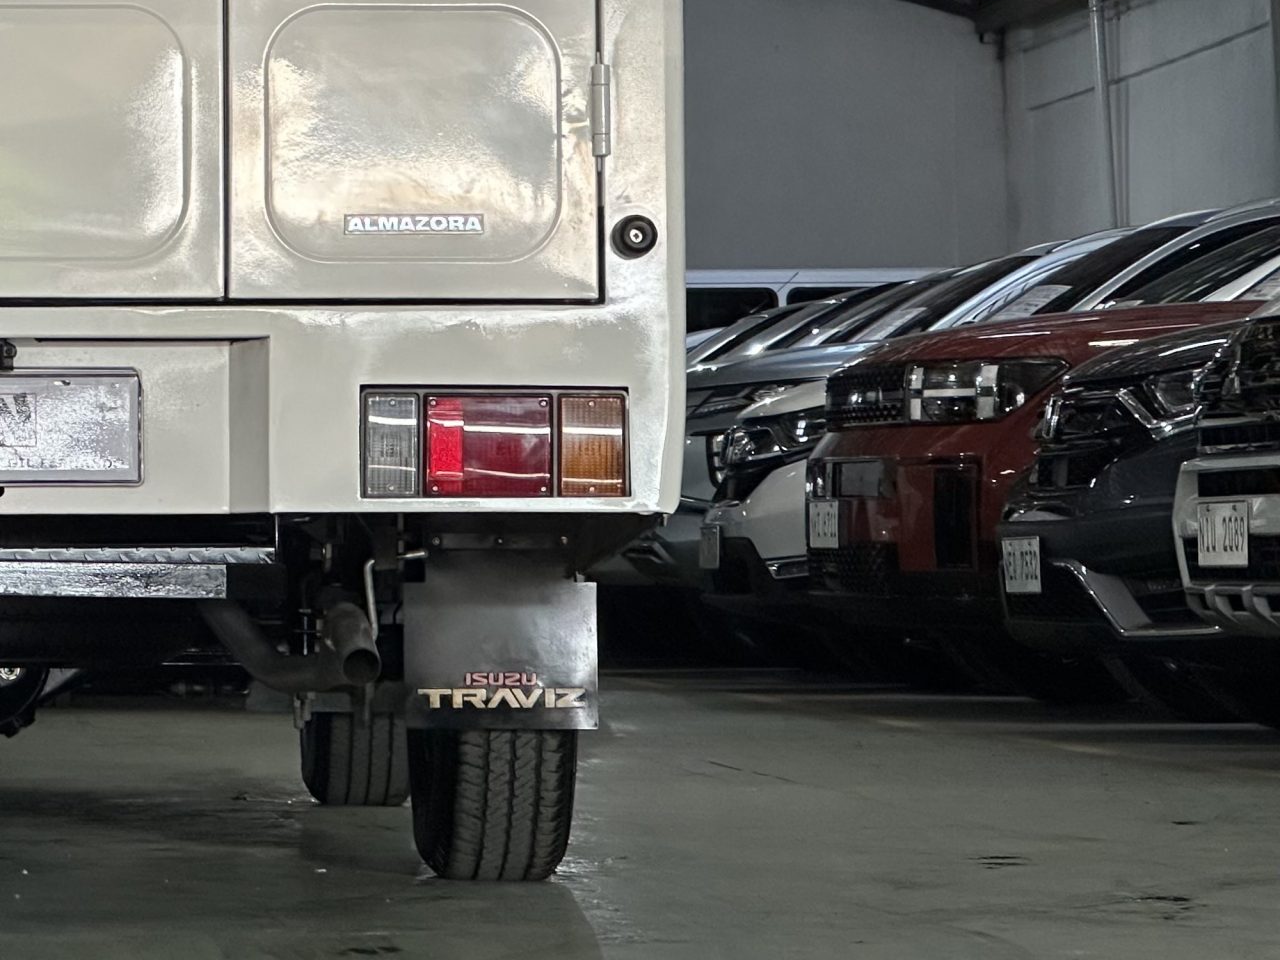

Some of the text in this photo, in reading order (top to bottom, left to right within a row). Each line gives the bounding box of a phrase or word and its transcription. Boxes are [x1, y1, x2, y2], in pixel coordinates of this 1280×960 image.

[348, 216, 482, 232] ALMAZORA
[1222, 516, 1244, 552] 2089
[465, 672, 538, 686] ISUZU
[417, 688, 586, 709] TRAVIZ
